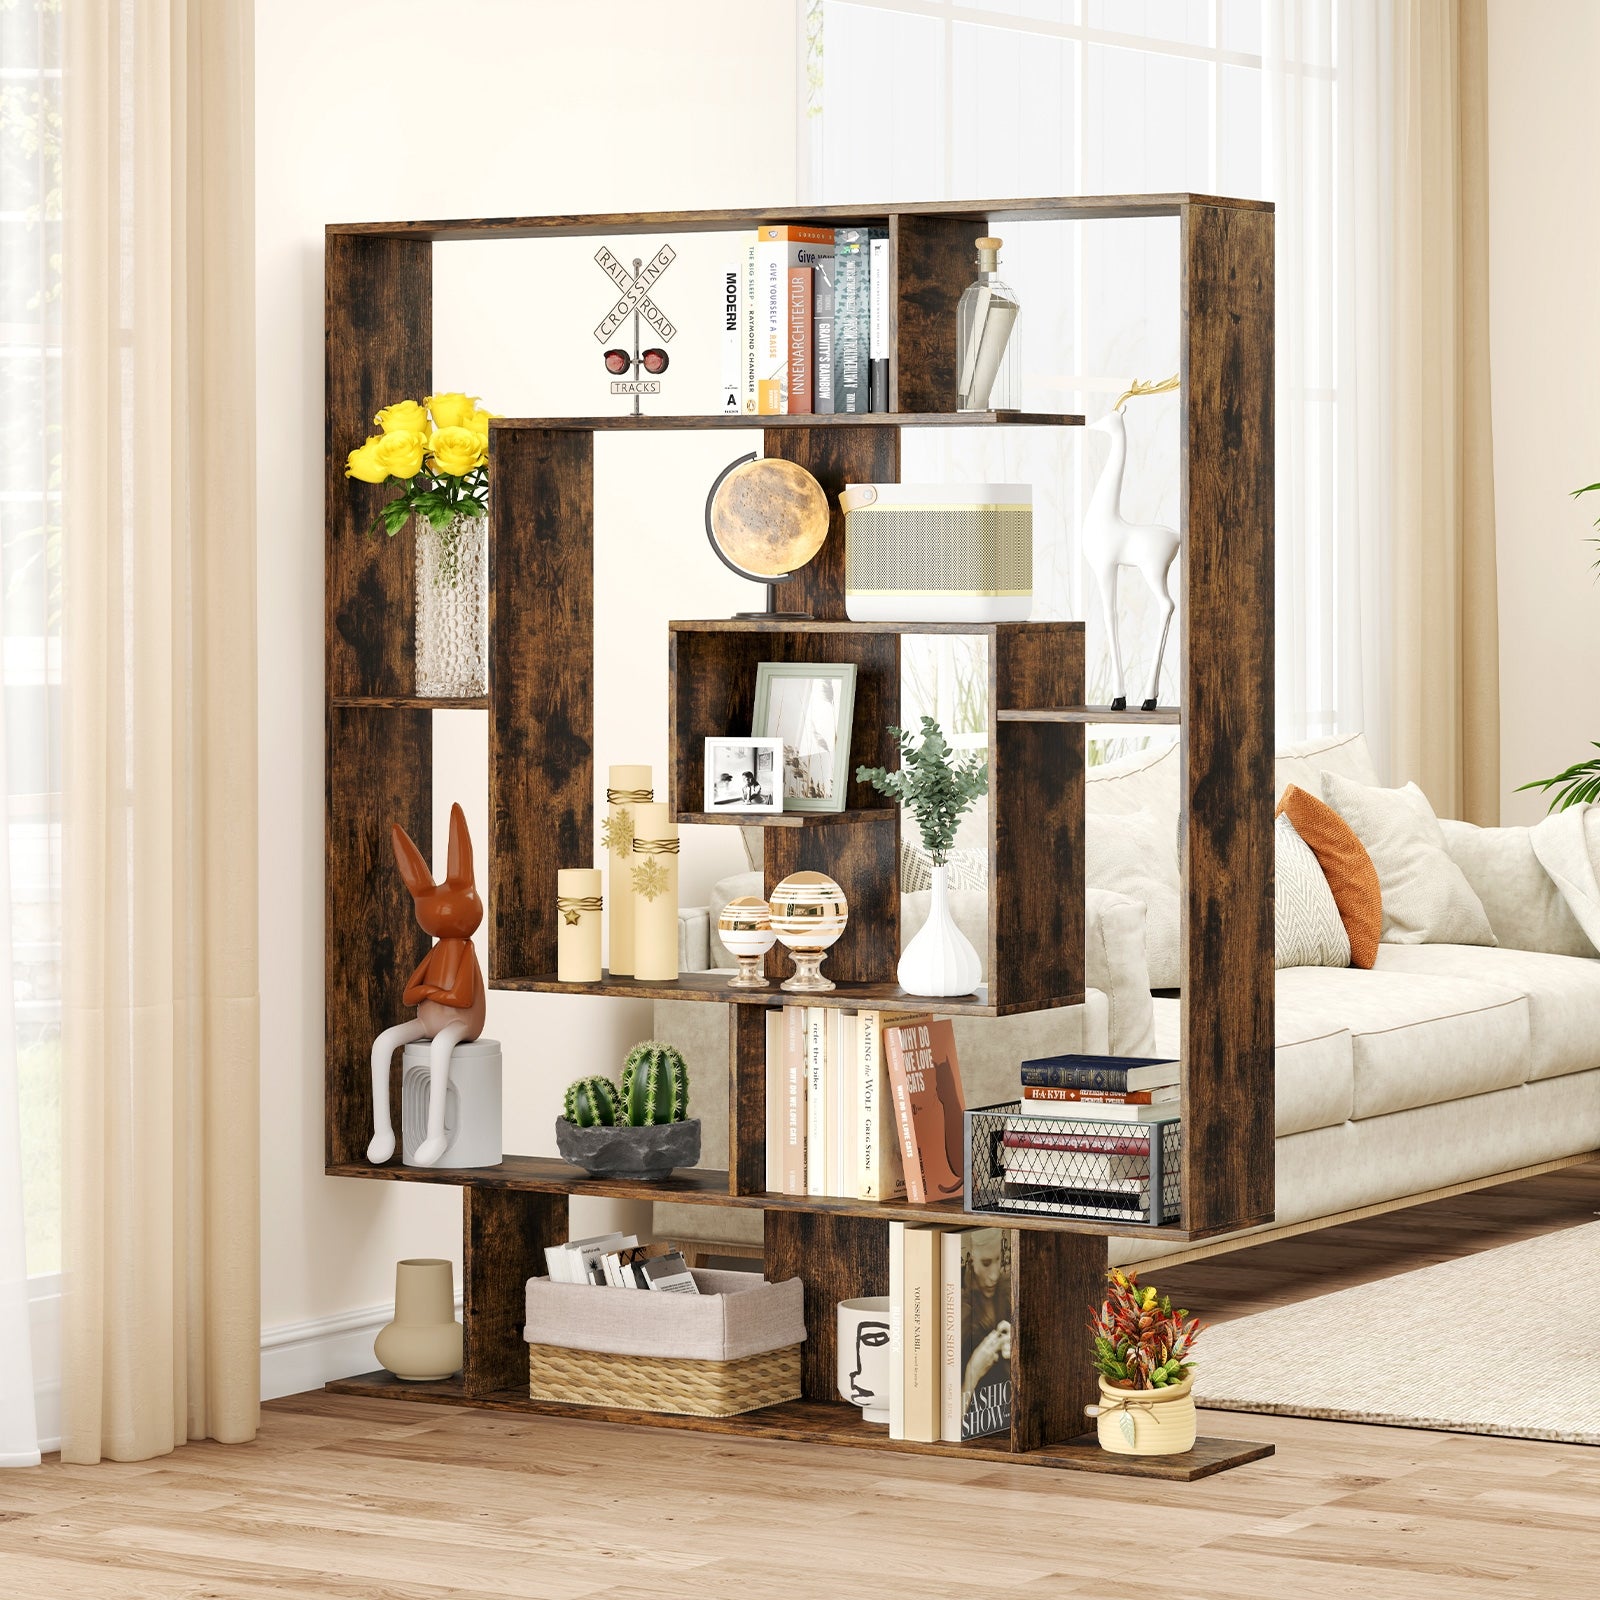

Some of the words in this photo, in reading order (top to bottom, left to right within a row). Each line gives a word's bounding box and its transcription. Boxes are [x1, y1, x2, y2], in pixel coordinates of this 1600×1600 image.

[797, 249, 815, 263] Give
[769, 263, 777, 281] GIVE
[600, 251, 670, 336] CROSSING
[600, 252, 627, 287] RAIL
[639, 300, 672, 337] ROAD
[726, 272, 737, 331] MODERN
[769, 284, 777, 324] YOURSELF
[769, 334, 777, 359] RAISE
[792, 276, 805, 395] INNENARCHITEKTUR
[819, 323, 831, 362] GRAVITY'S
[615, 383, 656, 392] TRACKS
[819, 364, 831, 400] RAINBOW
[727, 393, 737, 406] A
[864, 1015, 873, 1062] TAMING
[899, 1028, 918, 1049] WHY
[919, 1025, 930, 1046] DO
[903, 1052, 916, 1072] WE
[917, 1048, 934, 1070] LOVE
[789, 1067, 797, 1083] WHY
[906, 1074, 925, 1094] CATS
[789, 1084, 797, 1095] DO
[864, 1079, 873, 1112] WOLF
[789, 1096, 797, 1108] WE
[899, 1101, 906, 1111] DO
[789, 1108, 797, 1126] LOVE
[901, 1112, 908, 1124] WE
[903, 1125, 911, 1142] LOVE
[905, 1142, 913, 1158] CATS
[946, 1283, 954, 1331] FASHION
[946, 1334, 954, 1368] SHOW
[962, 1381, 1012, 1415] FASHIO
[962, 1405, 1004, 1438] SHOW
